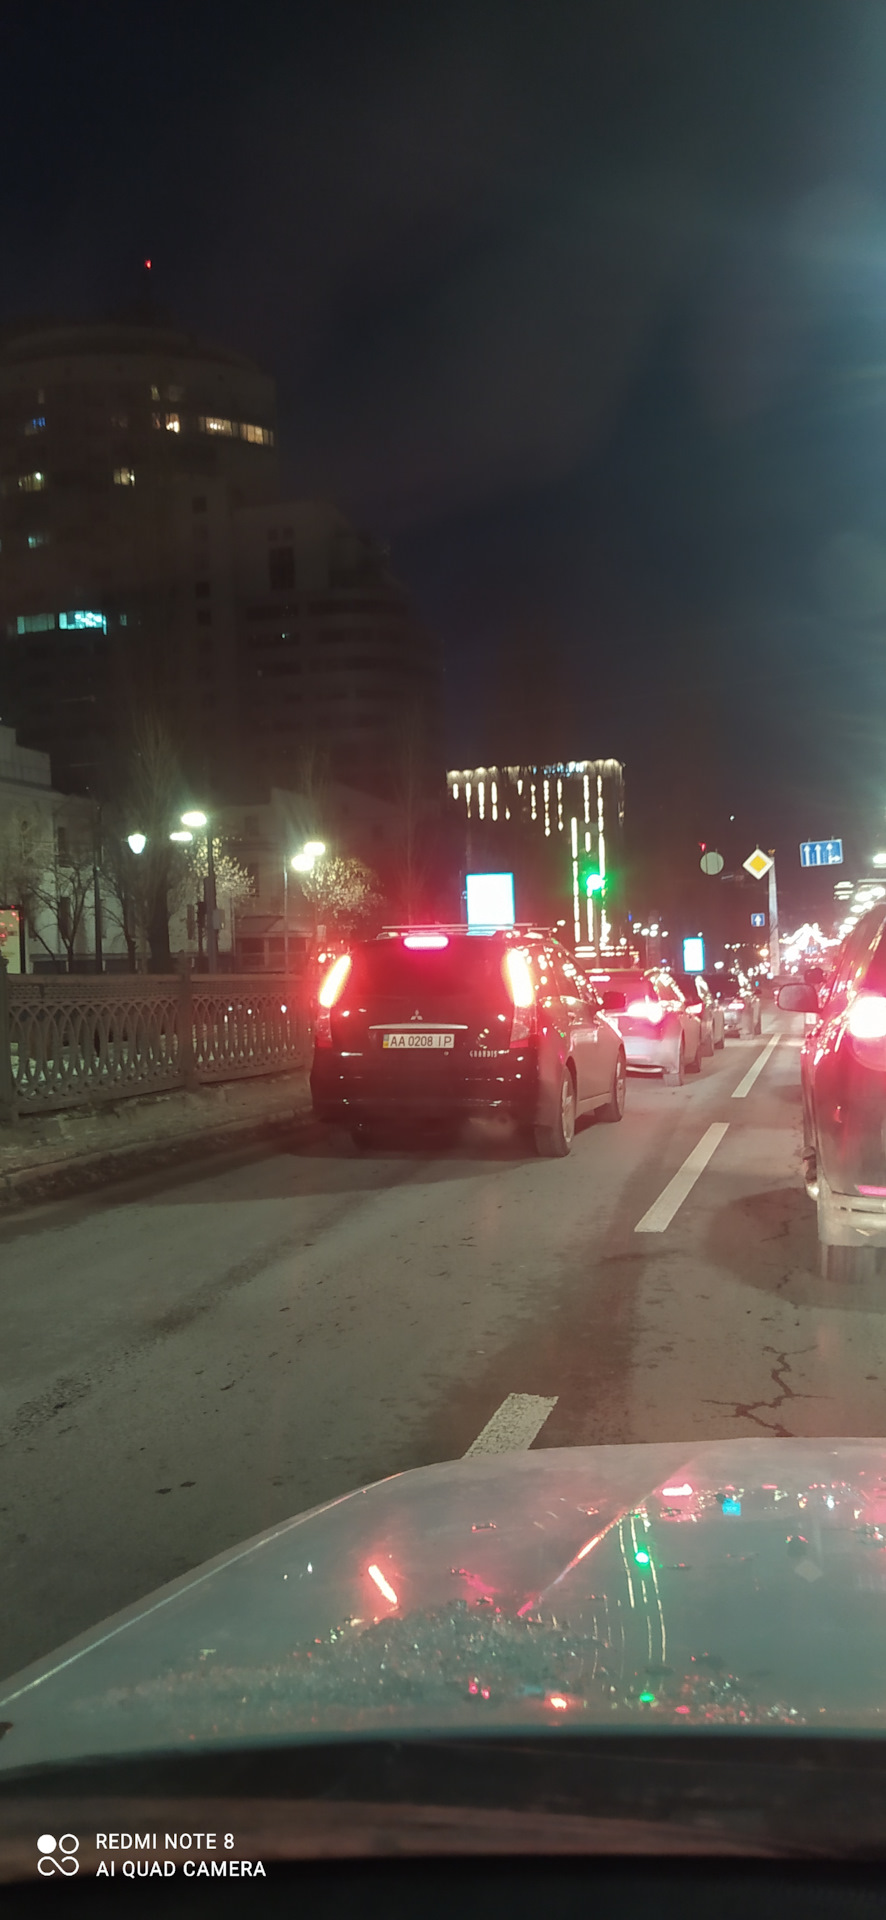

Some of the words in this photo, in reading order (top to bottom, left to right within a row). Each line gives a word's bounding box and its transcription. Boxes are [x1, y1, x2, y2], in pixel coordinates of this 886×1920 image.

[390, 1036, 406, 1047] AA
[408, 1036, 433, 1047] 0208
[438, 1036, 452, 1047] IP
